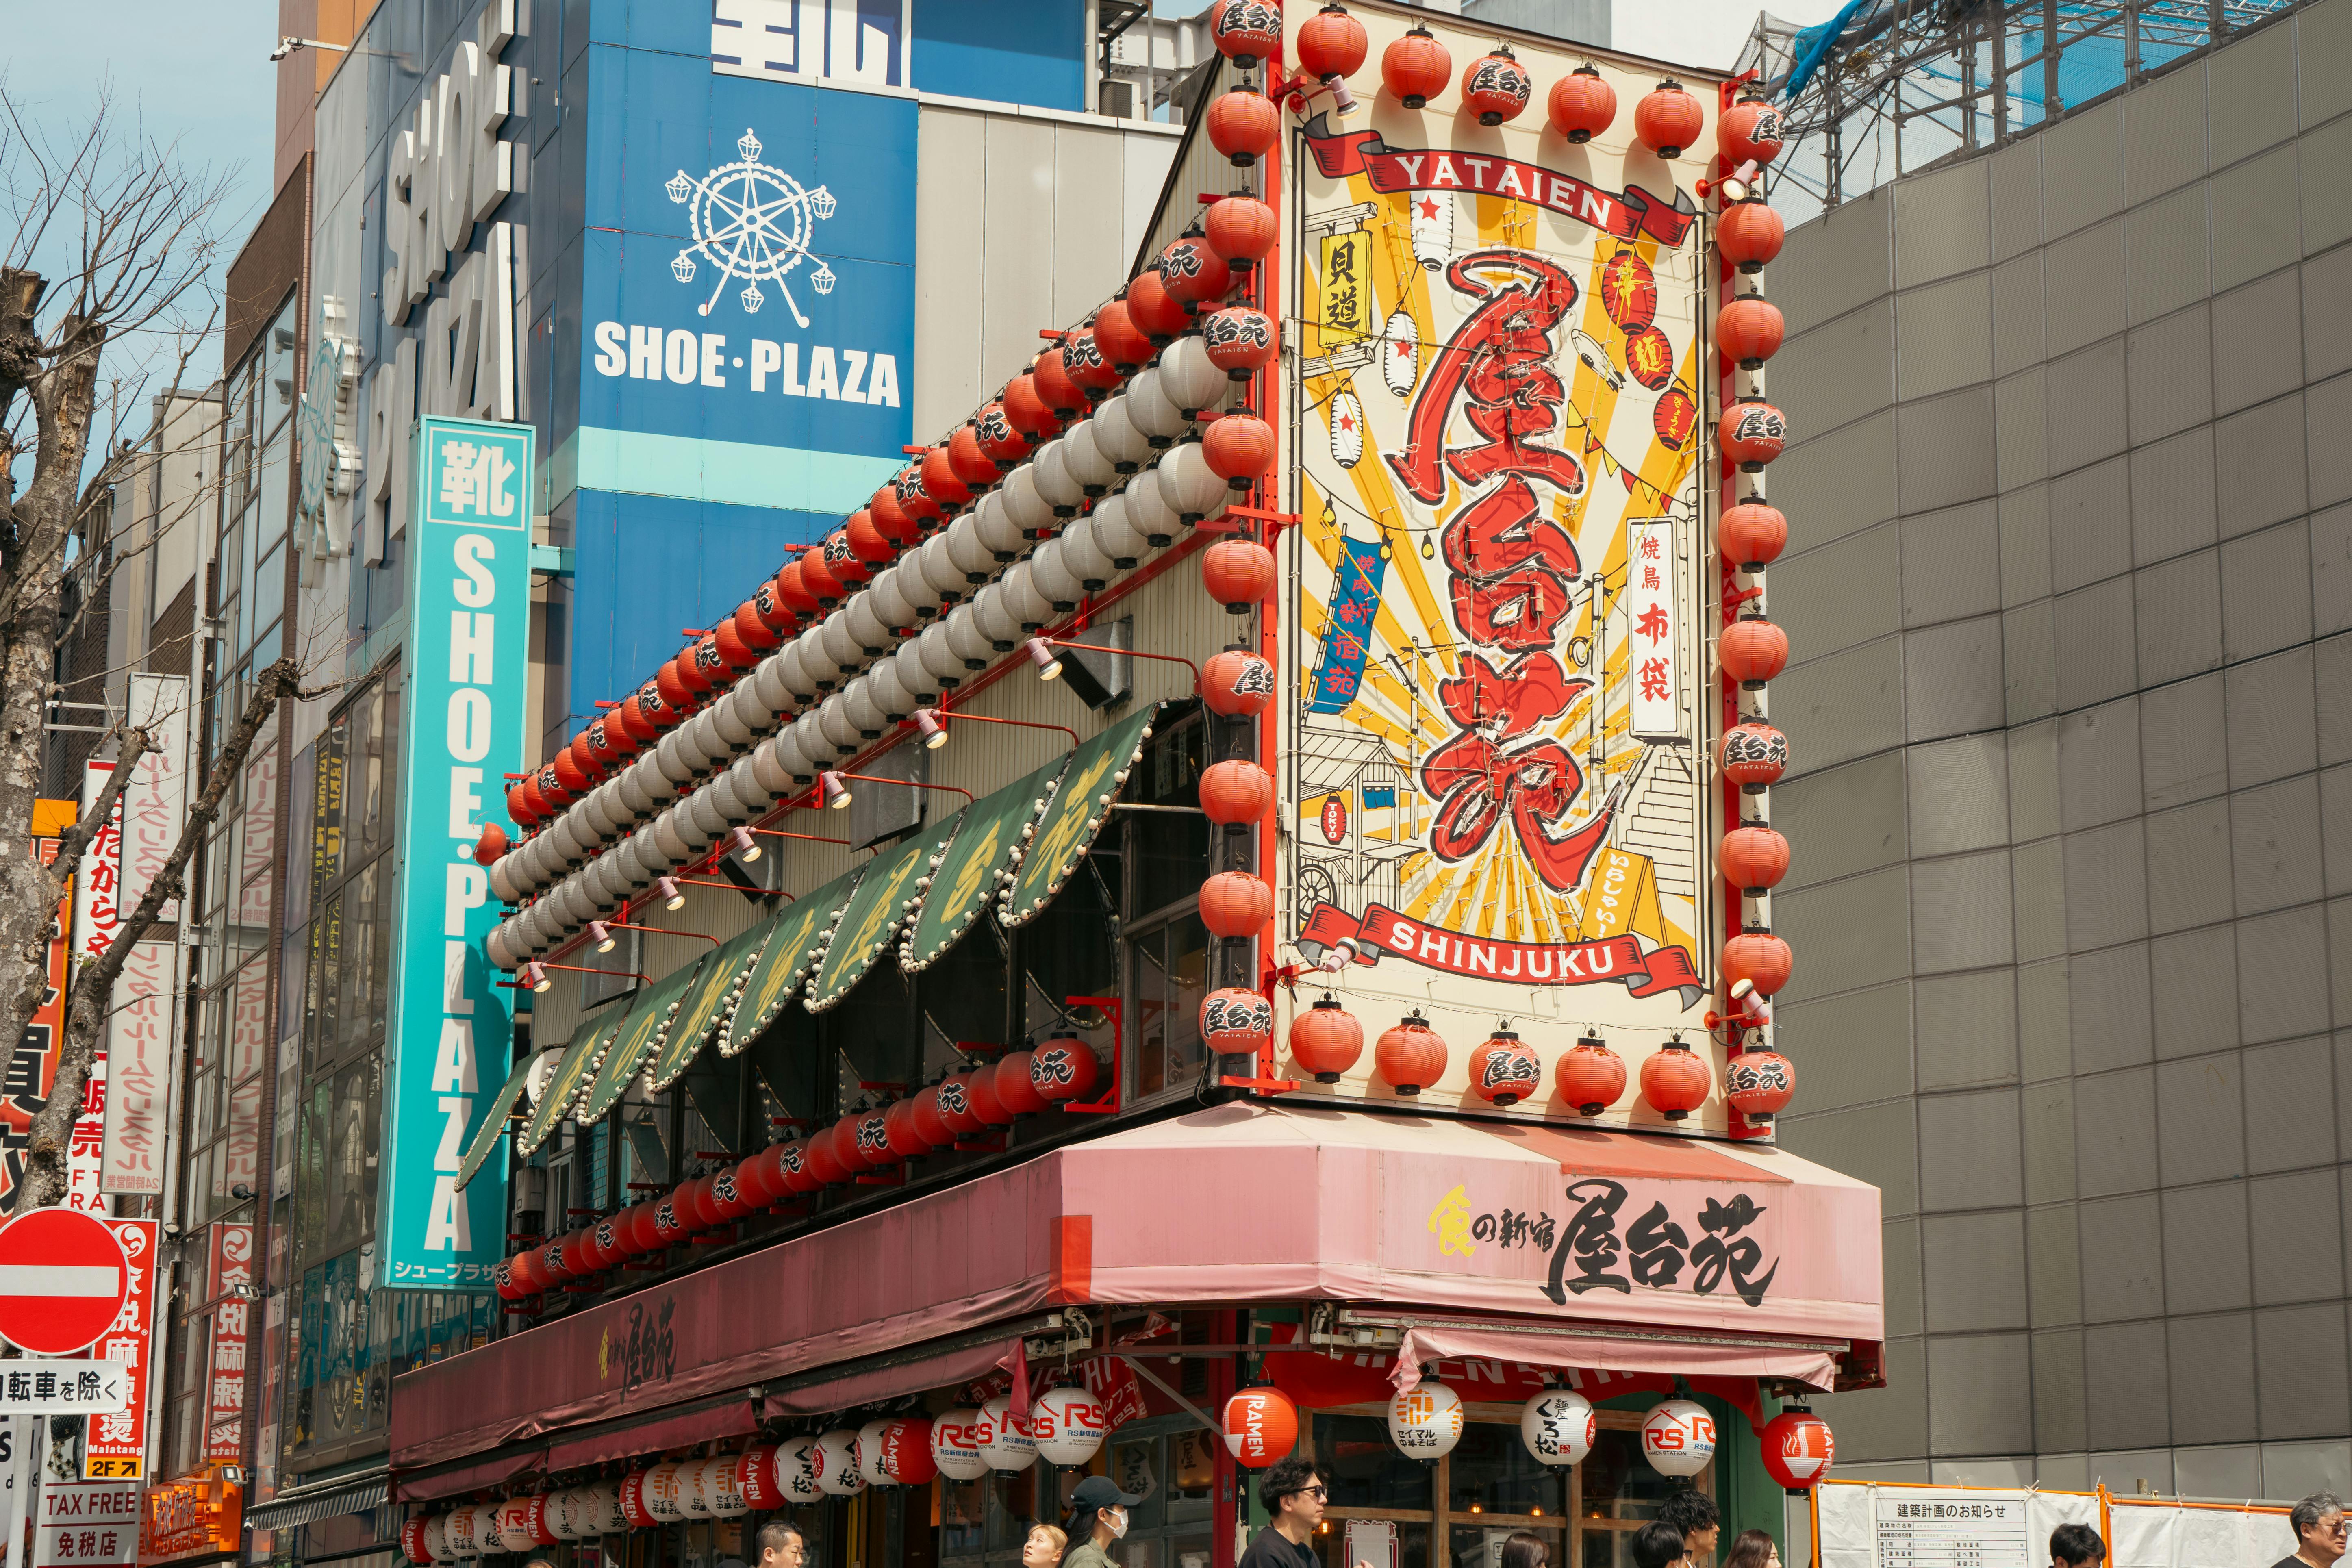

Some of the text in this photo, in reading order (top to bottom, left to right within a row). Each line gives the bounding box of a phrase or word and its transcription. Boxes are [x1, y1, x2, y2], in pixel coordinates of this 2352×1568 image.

[1237, 33, 1272, 43] YATAIEN
[1486, 92, 1519, 107] YATAIEN
[383, 0, 514, 326] SHOE
[1395, 155, 1612, 228] YATAIEN
[1213, 347, 1249, 355] YATAIEN
[440, 440, 515, 517] 靴
[1382, 247, 1627, 896] 屋台苑
[1328, 804, 1337, 839] TOKYO
[1389, 922, 1614, 978] SHINJUKU
[0, 1371, 117, 1403] 転車を除く
[1064, 1403, 1105, 1429] RS
[1554, 1398, 1569, 1420] 麺屋
[1246, 1394, 1265, 1457] RAMEN
[1397, 1429, 1435, 1438] セイマル
[1535, 1398, 1559, 1456] くろ松
[1646, 1429, 1684, 1450] RS
[89, 1444, 143, 1456] Malatang
[888, 1425, 903, 1475] RAMEN
[1399, 1438, 1437, 1447] 中華そば
[92, 1461, 115, 1477] 2F
[746, 1451, 762, 1500] RAMEN
[46, 1492, 135, 1516] TAX FREE
[625, 1478, 639, 1519] RAMEN
[652, 1499, 676, 1508] セイマ
[1898, 1504, 2005, 1518] 建築計画のお知らせ
[529, 1500, 540, 1538] RAMEN
[57, 1531, 117, 1558] 免税店
[404, 1523, 417, 1559] RAMEN
